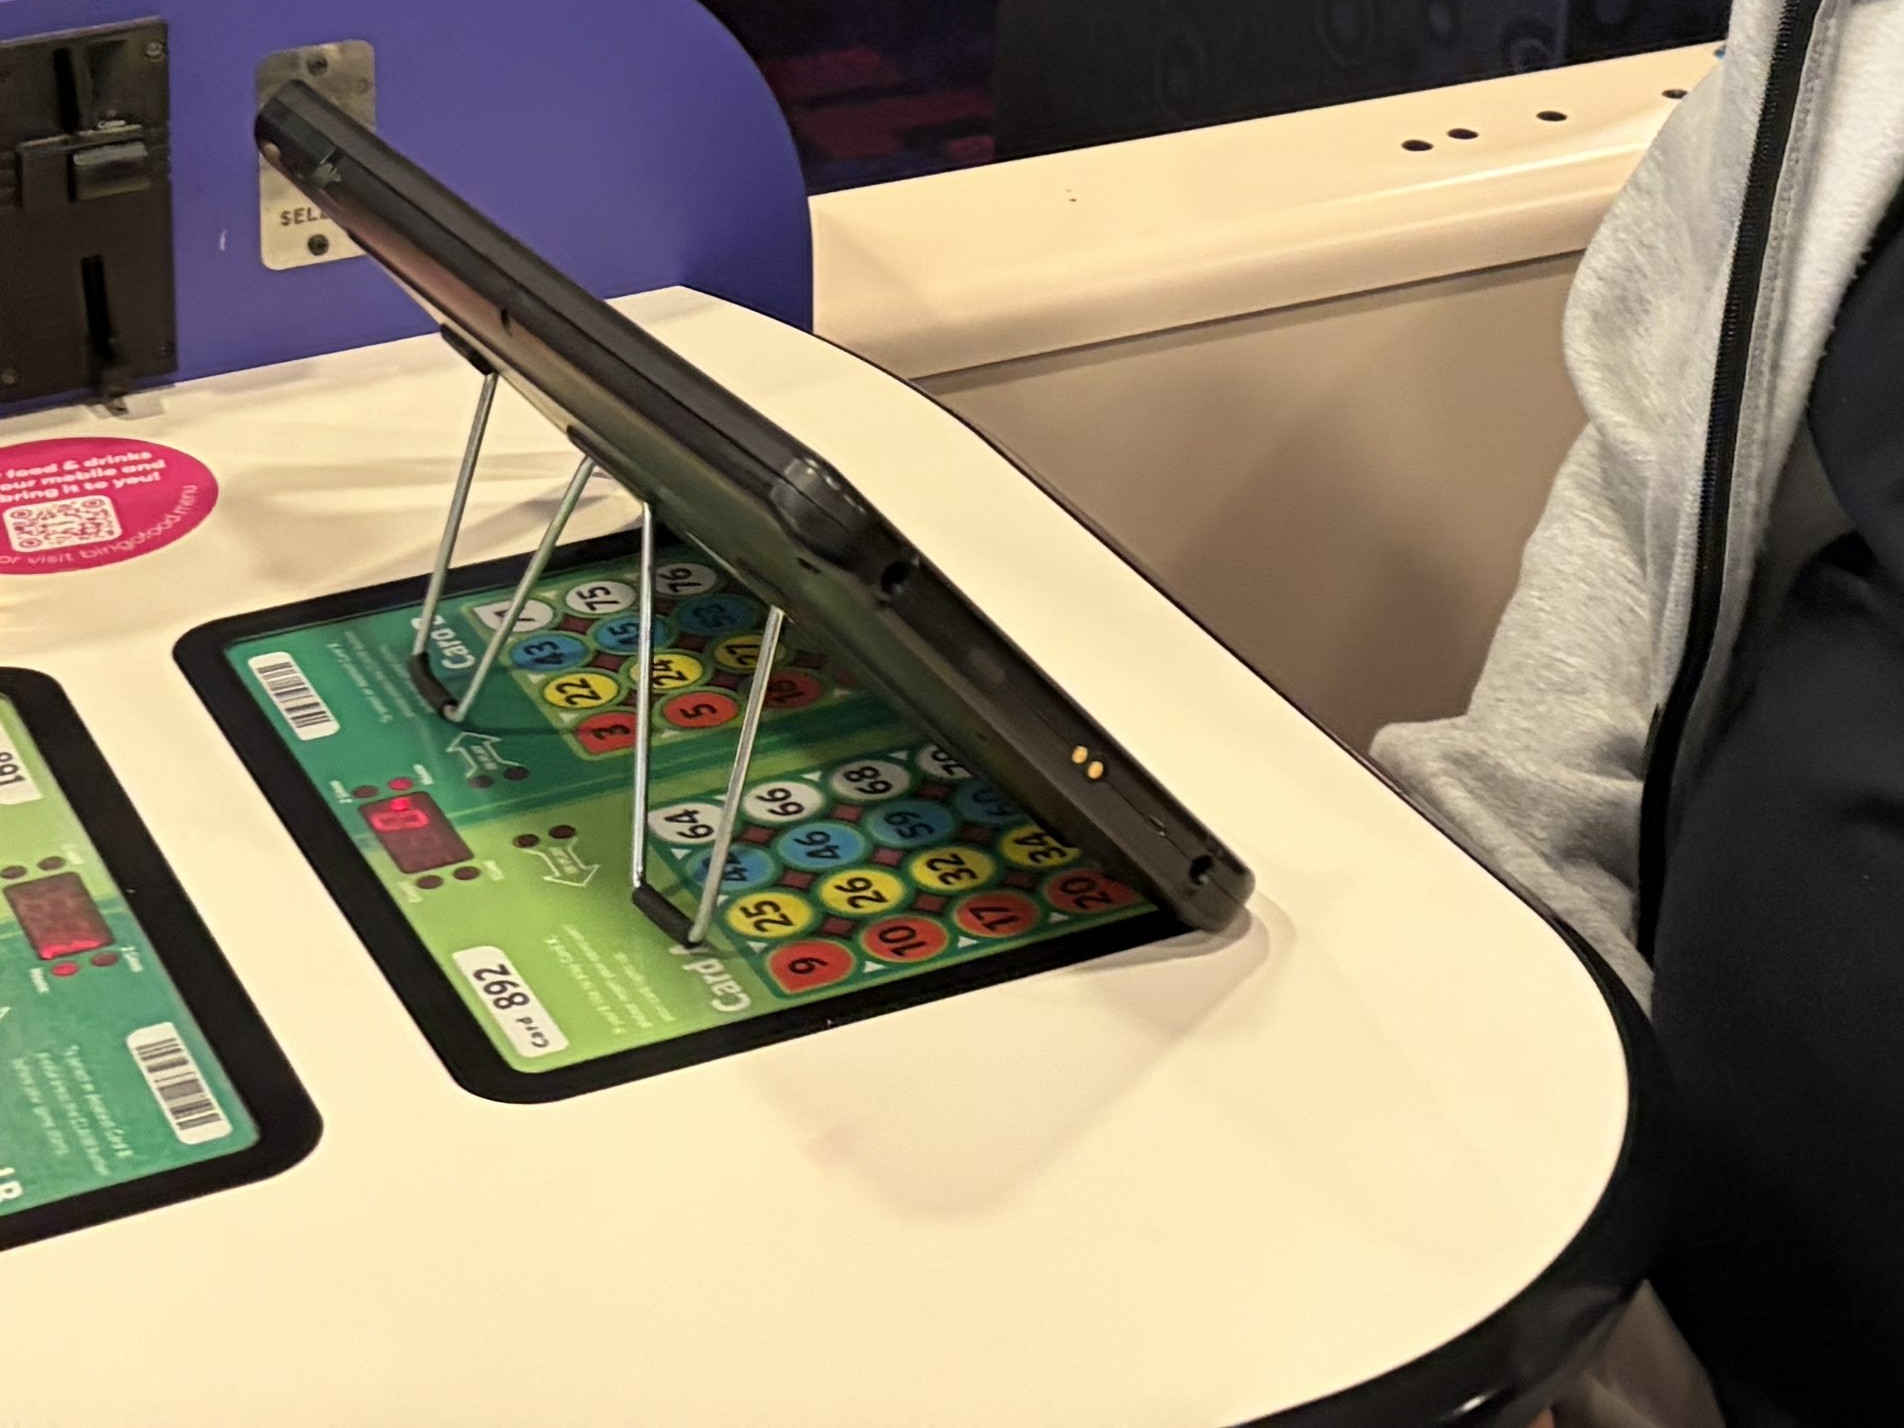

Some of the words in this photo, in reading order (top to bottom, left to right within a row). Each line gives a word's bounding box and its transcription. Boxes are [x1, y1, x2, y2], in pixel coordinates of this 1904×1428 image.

[6, 463, 58, 479] food
[83, 451, 152, 467] drinks
[41, 467, 117, 485] mobile
[121, 458, 166, 474] and
[83, 480, 109, 491] to
[112, 471, 161, 489] you!
[27, 551, 74, 565] visit
[657, 567, 702, 593] 76
[576, 587, 620, 611] 75
[523, 640, 566, 665] 43
[556, 679, 601, 706] 22
[680, 704, 716, 719] 5
[591, 723, 631, 741] 3
[844, 766, 892, 794] 68
[756, 788, 804, 816] 66
[664, 810, 714, 839] 64
[883, 810, 934, 841] 59
[794, 831, 840, 859] 46
[1012, 831, 1066, 866] 34
[927, 853, 978, 885] 32
[835, 877, 888, 908] 26
[1060, 875, 1113, 909] 20
[740, 901, 794, 932] 25
[970, 906, 1021, 930] 17
[879, 926, 926, 956] 10
[789, 958, 827, 974] 9
[473, 964, 529, 1009] 892
[682, 959, 752, 1013] Card
[516, 1017, 549, 1048] Card
